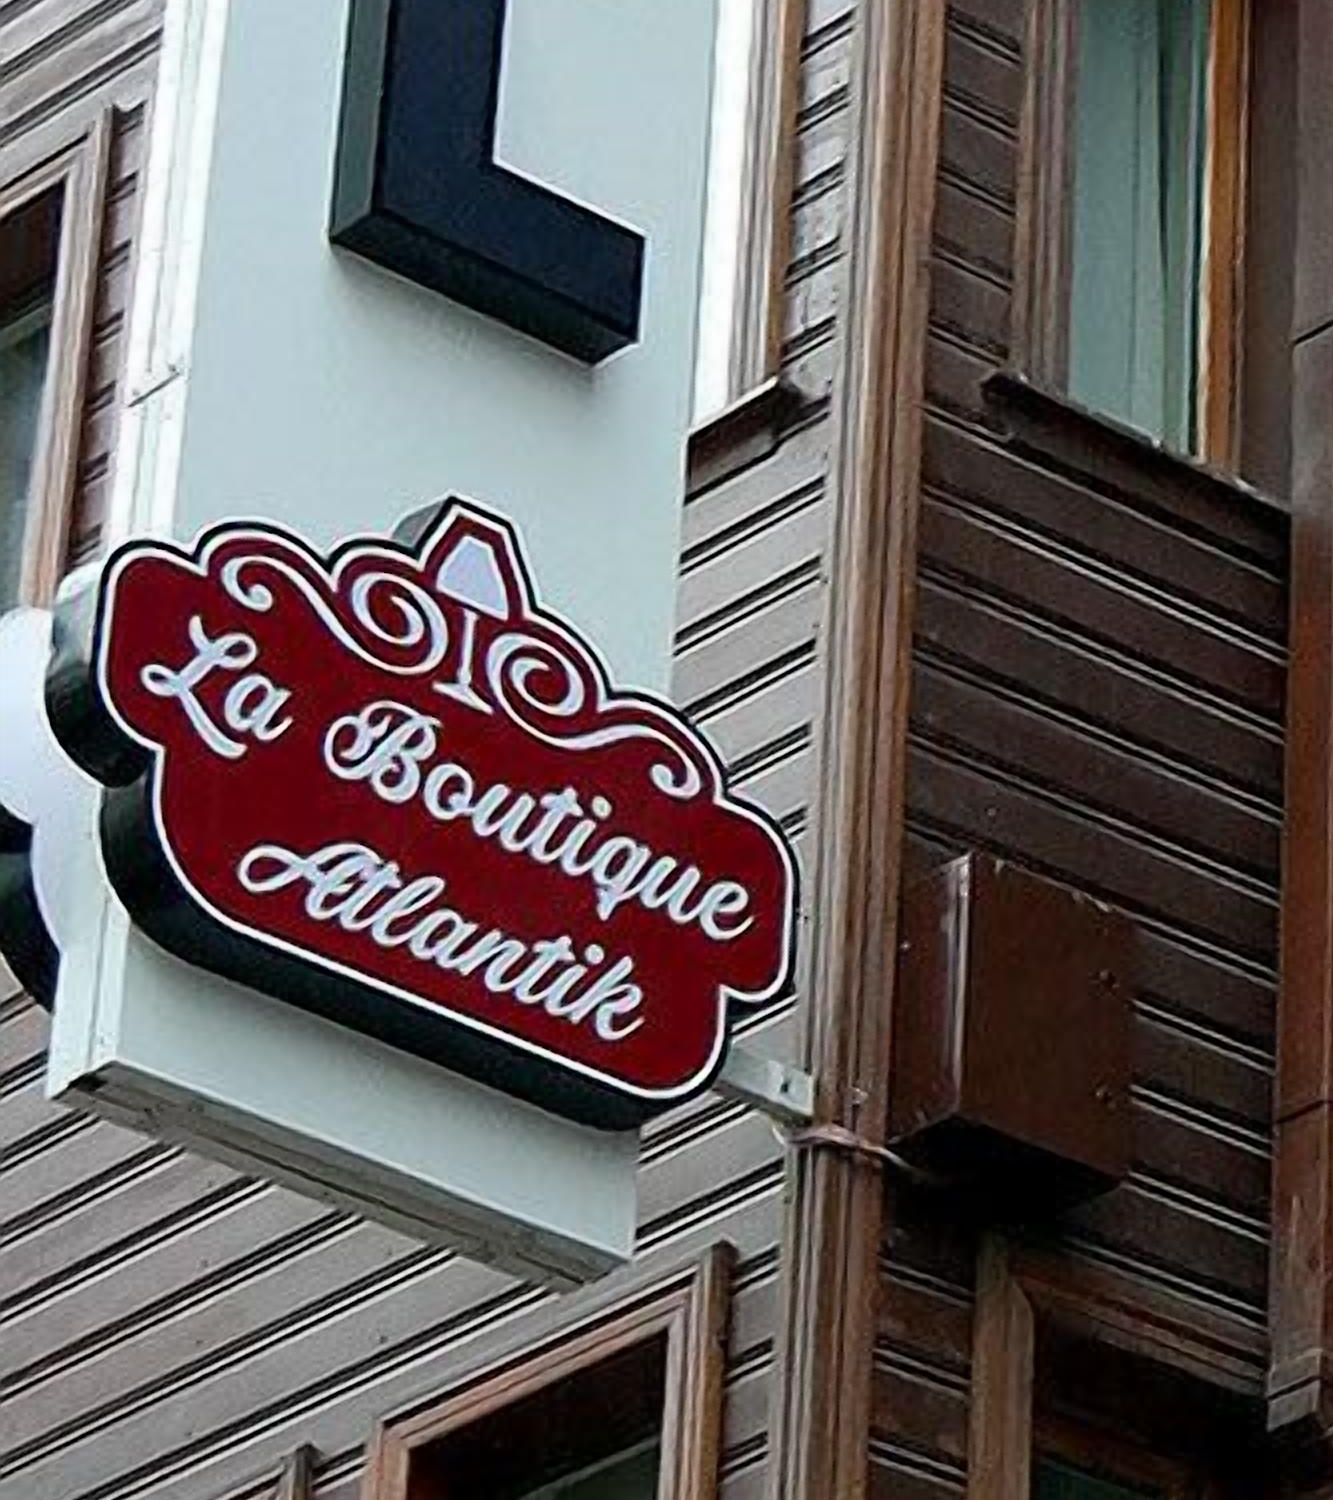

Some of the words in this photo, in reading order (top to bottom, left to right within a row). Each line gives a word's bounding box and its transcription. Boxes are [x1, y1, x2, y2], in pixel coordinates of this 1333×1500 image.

[143, 616, 293, 758] La
[325, 700, 755, 941] Boutique
[238, 842, 645, 1041] Atlantik
